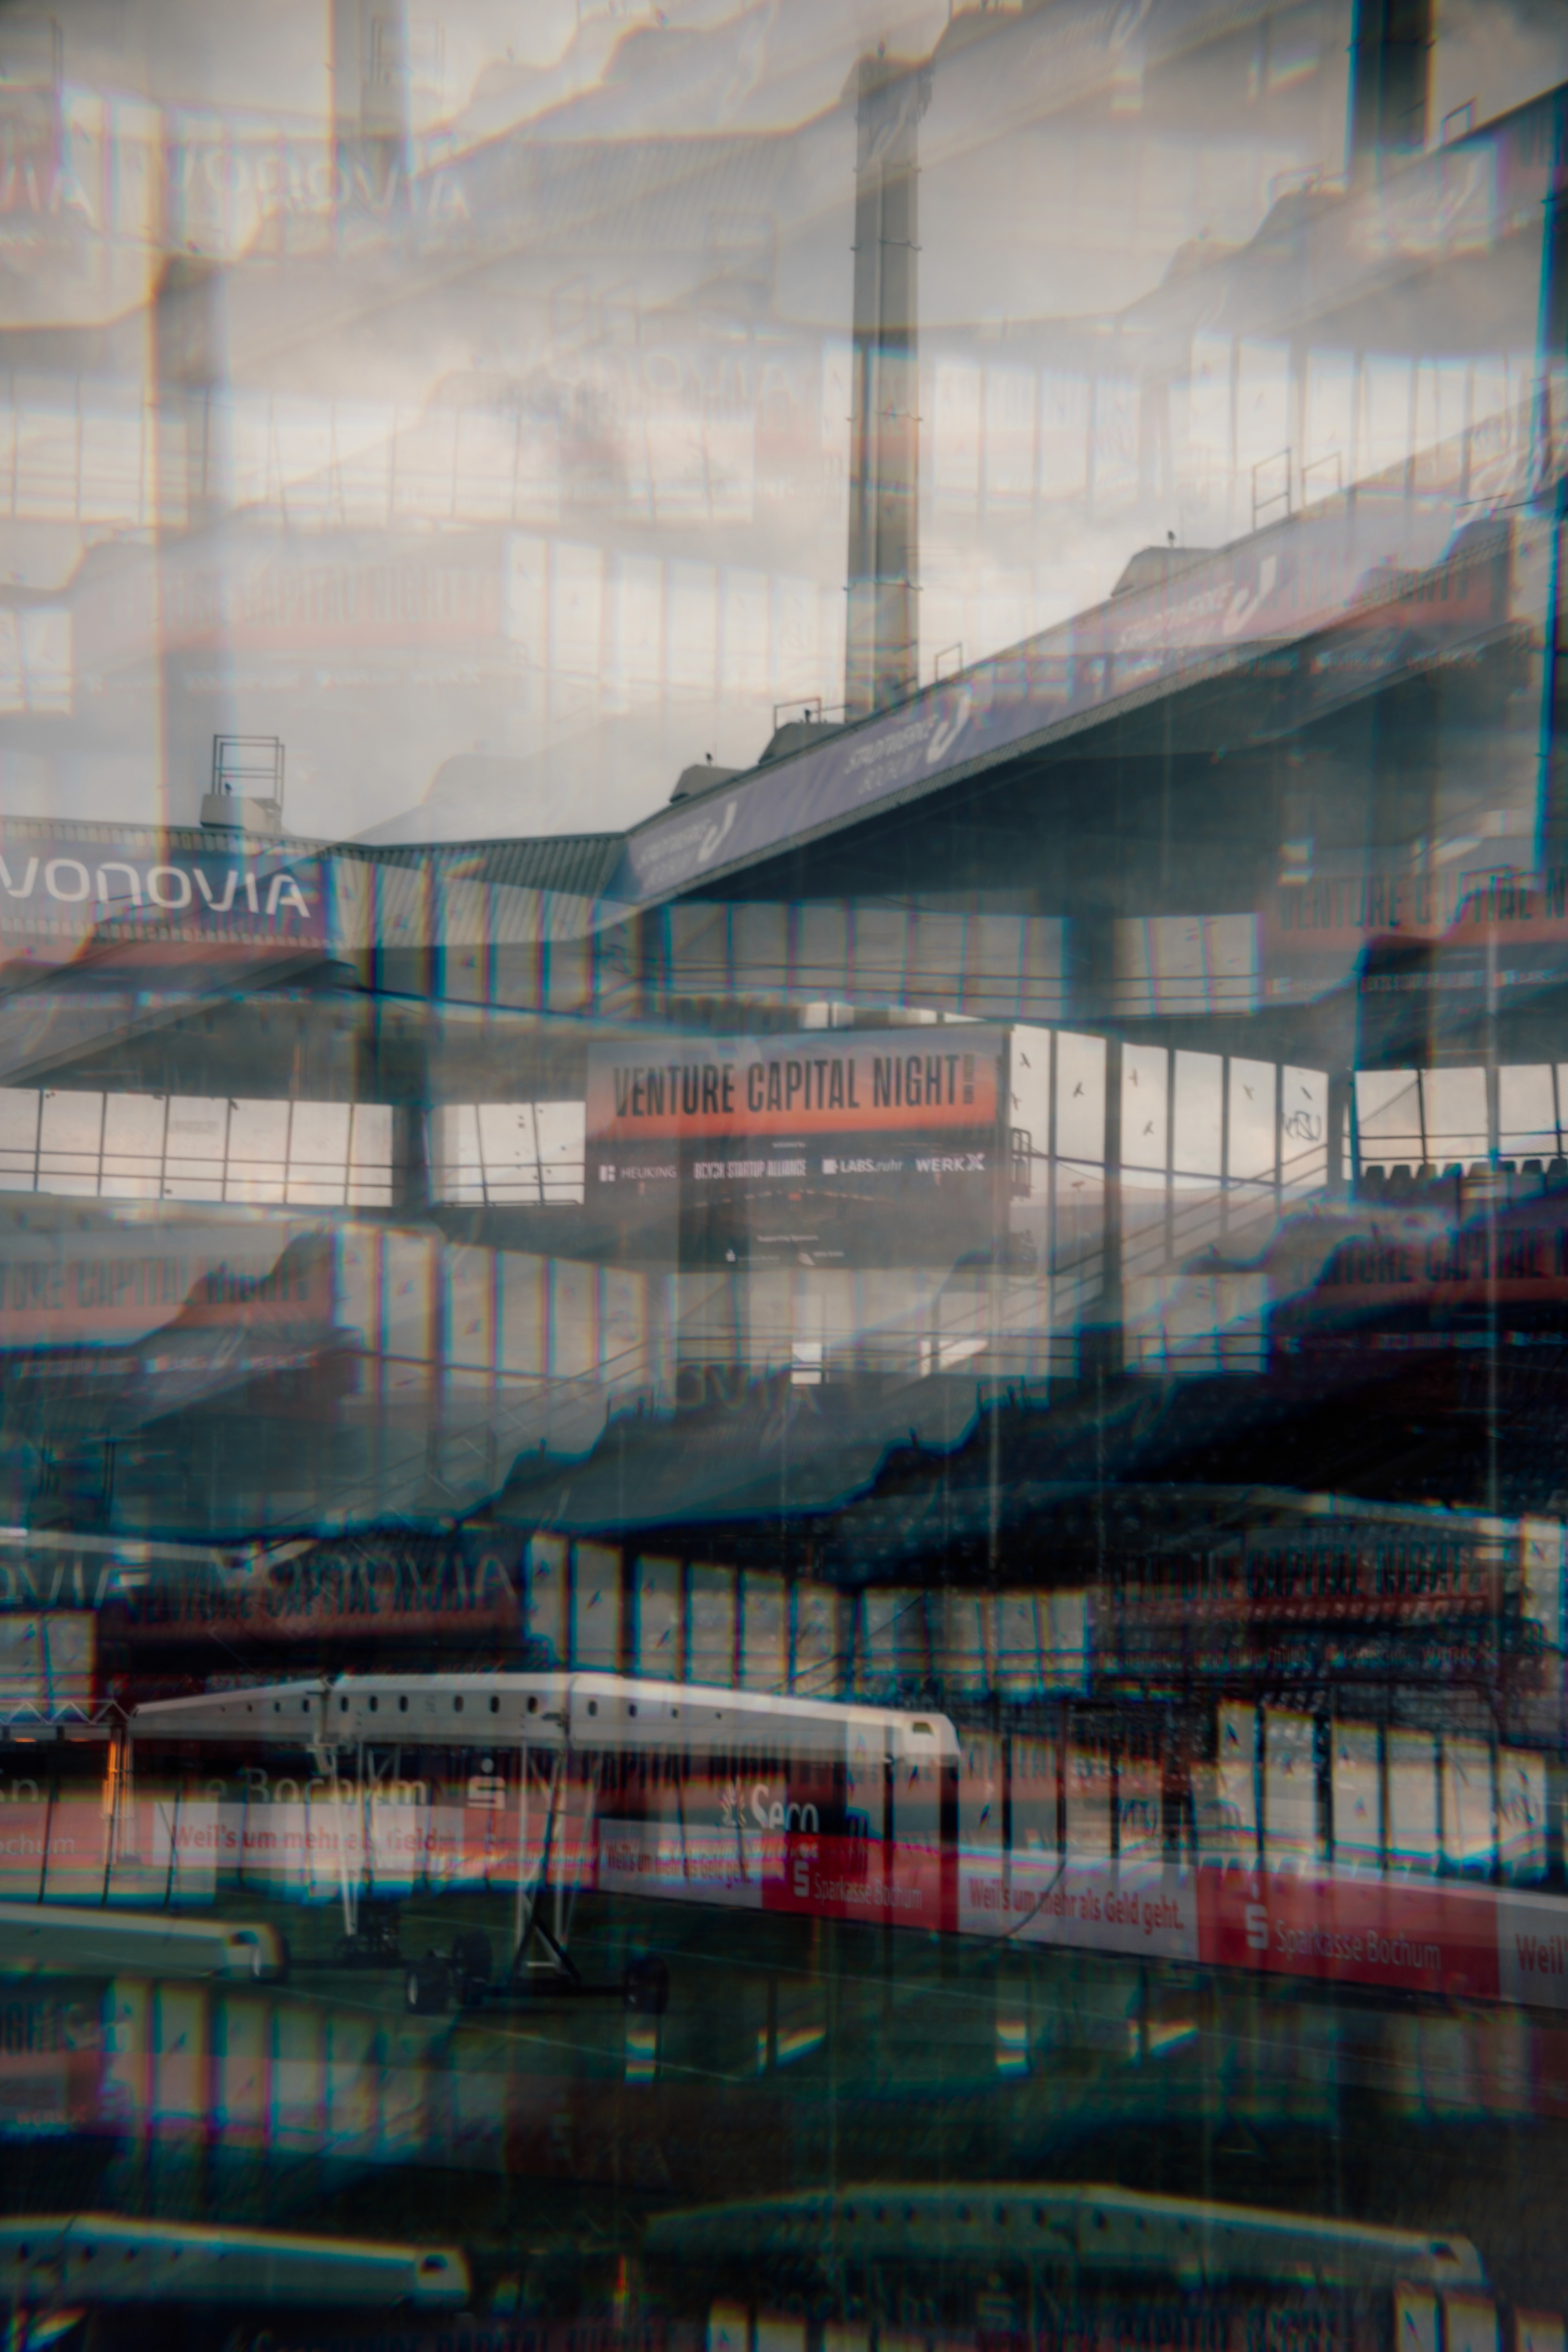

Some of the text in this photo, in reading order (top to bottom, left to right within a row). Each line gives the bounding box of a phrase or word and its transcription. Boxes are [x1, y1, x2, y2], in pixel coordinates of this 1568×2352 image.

[613, 1062, 735, 1117] VENTURE
[748, 1057, 861, 1113] CAPITAL
[873, 1053, 959, 1108] NIGHT
[620, 1165, 677, 1179] HEUKING
[969, 1878, 1184, 1936] Weil's um mehr als Geld geht.
[1274, 1919, 1441, 1971] Sparkasse Bochum
